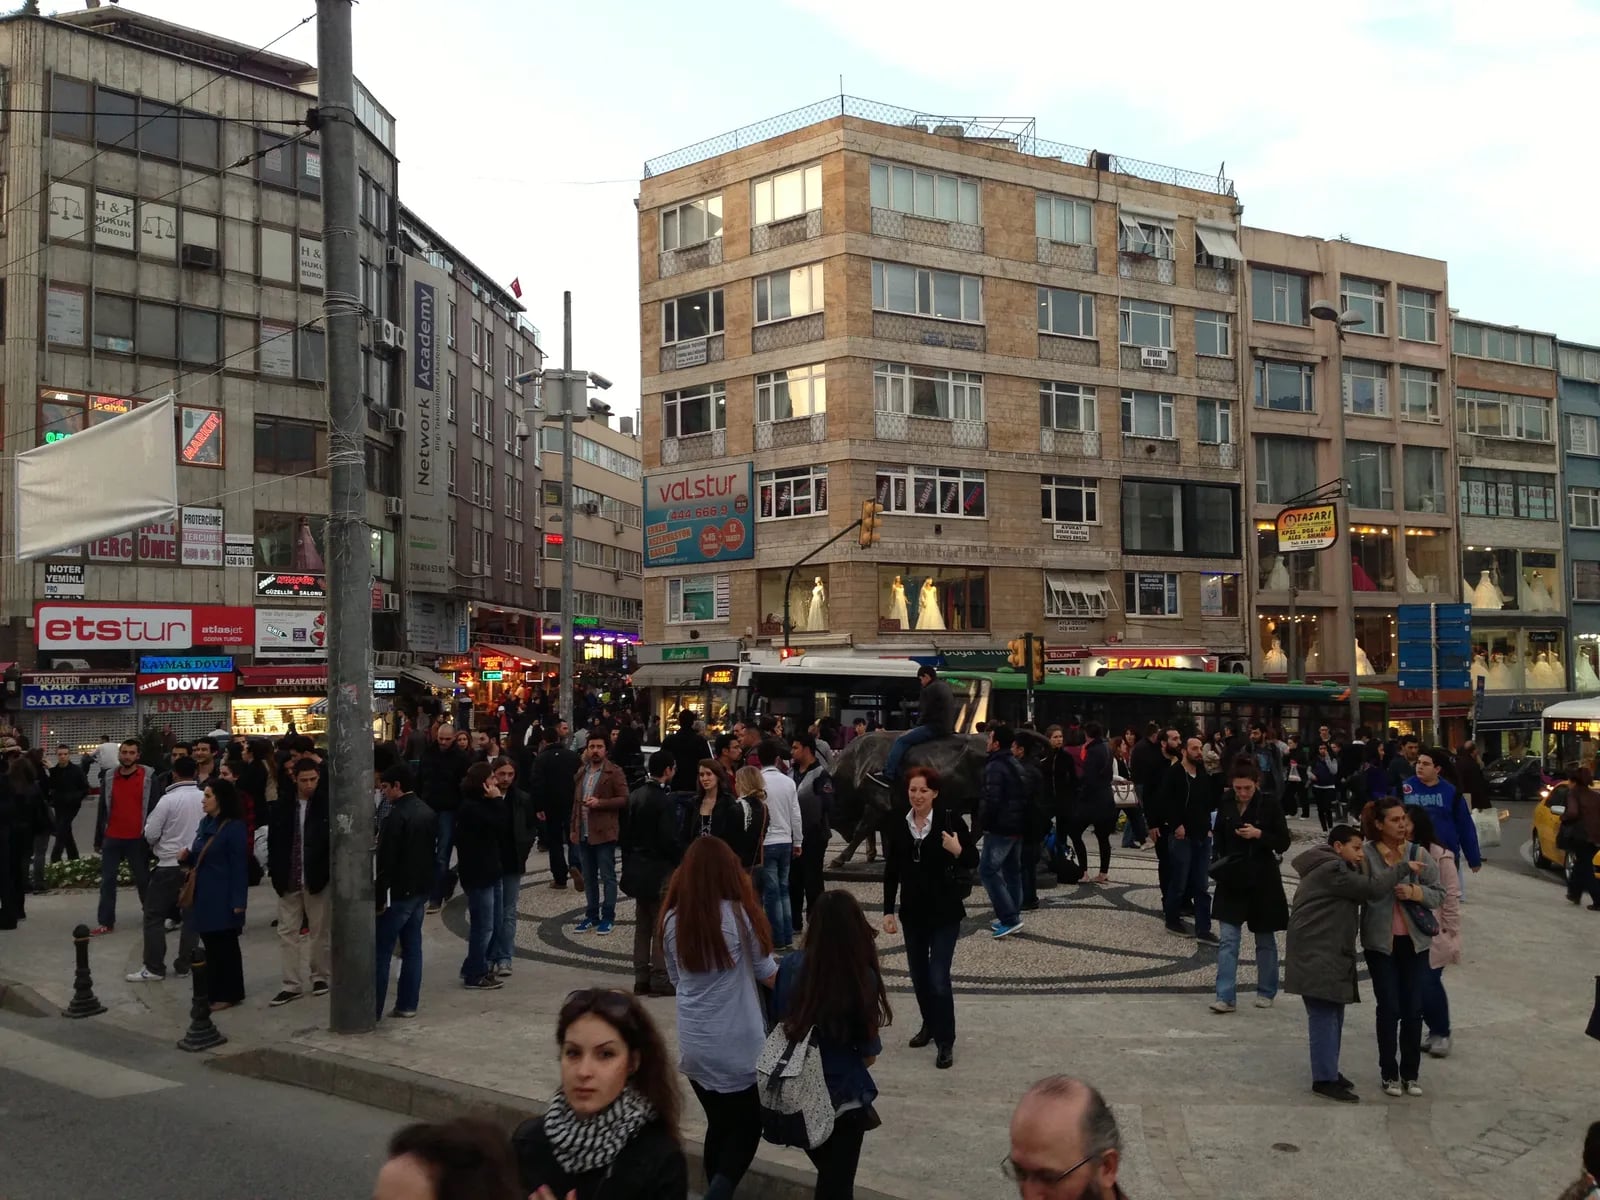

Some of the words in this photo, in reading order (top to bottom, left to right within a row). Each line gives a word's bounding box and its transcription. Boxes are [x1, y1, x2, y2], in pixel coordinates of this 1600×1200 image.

[95, 200, 106, 211] H
[110, 202, 121, 214] &
[123, 205, 132, 216] T
[95, 214, 131, 229] HUKUK
[301, 246, 310, 257] H
[313, 249, 321, 260] &
[418, 287, 433, 386] Academy
[417, 397, 431, 486] Network
[660, 474, 737, 502] valstur
[183, 512, 222, 527] PROTERCÜME
[671, 509, 691, 520] 444
[695, 506, 717, 518] 666
[720, 505, 729, 515] 9
[1297, 510, 1332, 522] TASARI
[50, 565, 81, 574] NOTER
[46, 573, 85, 584] YEMİNLİ
[45, 615, 186, 642] etstur
[201, 625, 244, 635] atlasjet
[33, 676, 80, 684] KARATEKİN
[167, 675, 219, 691] DÖVİZ
[26, 691, 130, 706] SARRAFİYE
